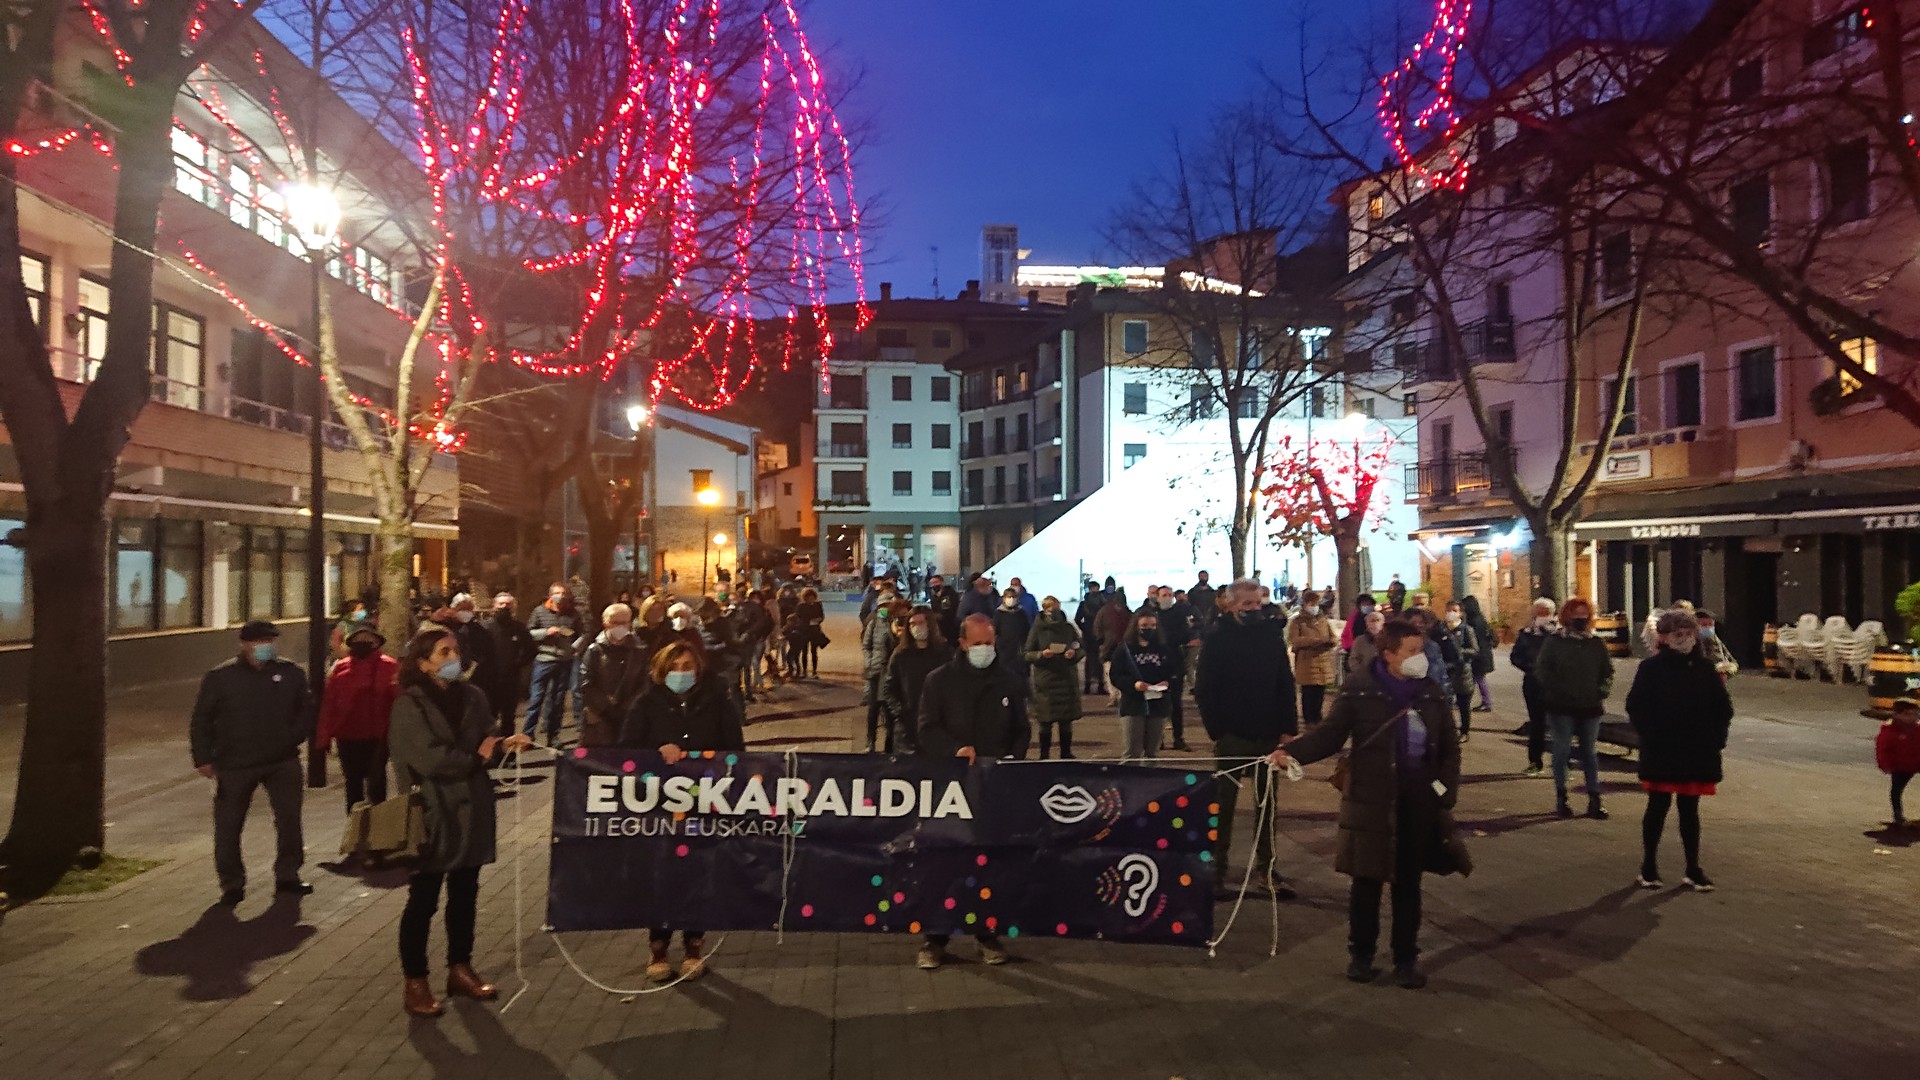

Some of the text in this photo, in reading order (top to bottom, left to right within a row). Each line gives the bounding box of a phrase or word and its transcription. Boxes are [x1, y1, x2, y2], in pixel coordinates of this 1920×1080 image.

[585, 774, 974, 819] EUSKARALDIA
[584, 816, 808, 839] 11 EGUN EUSKARAZ
